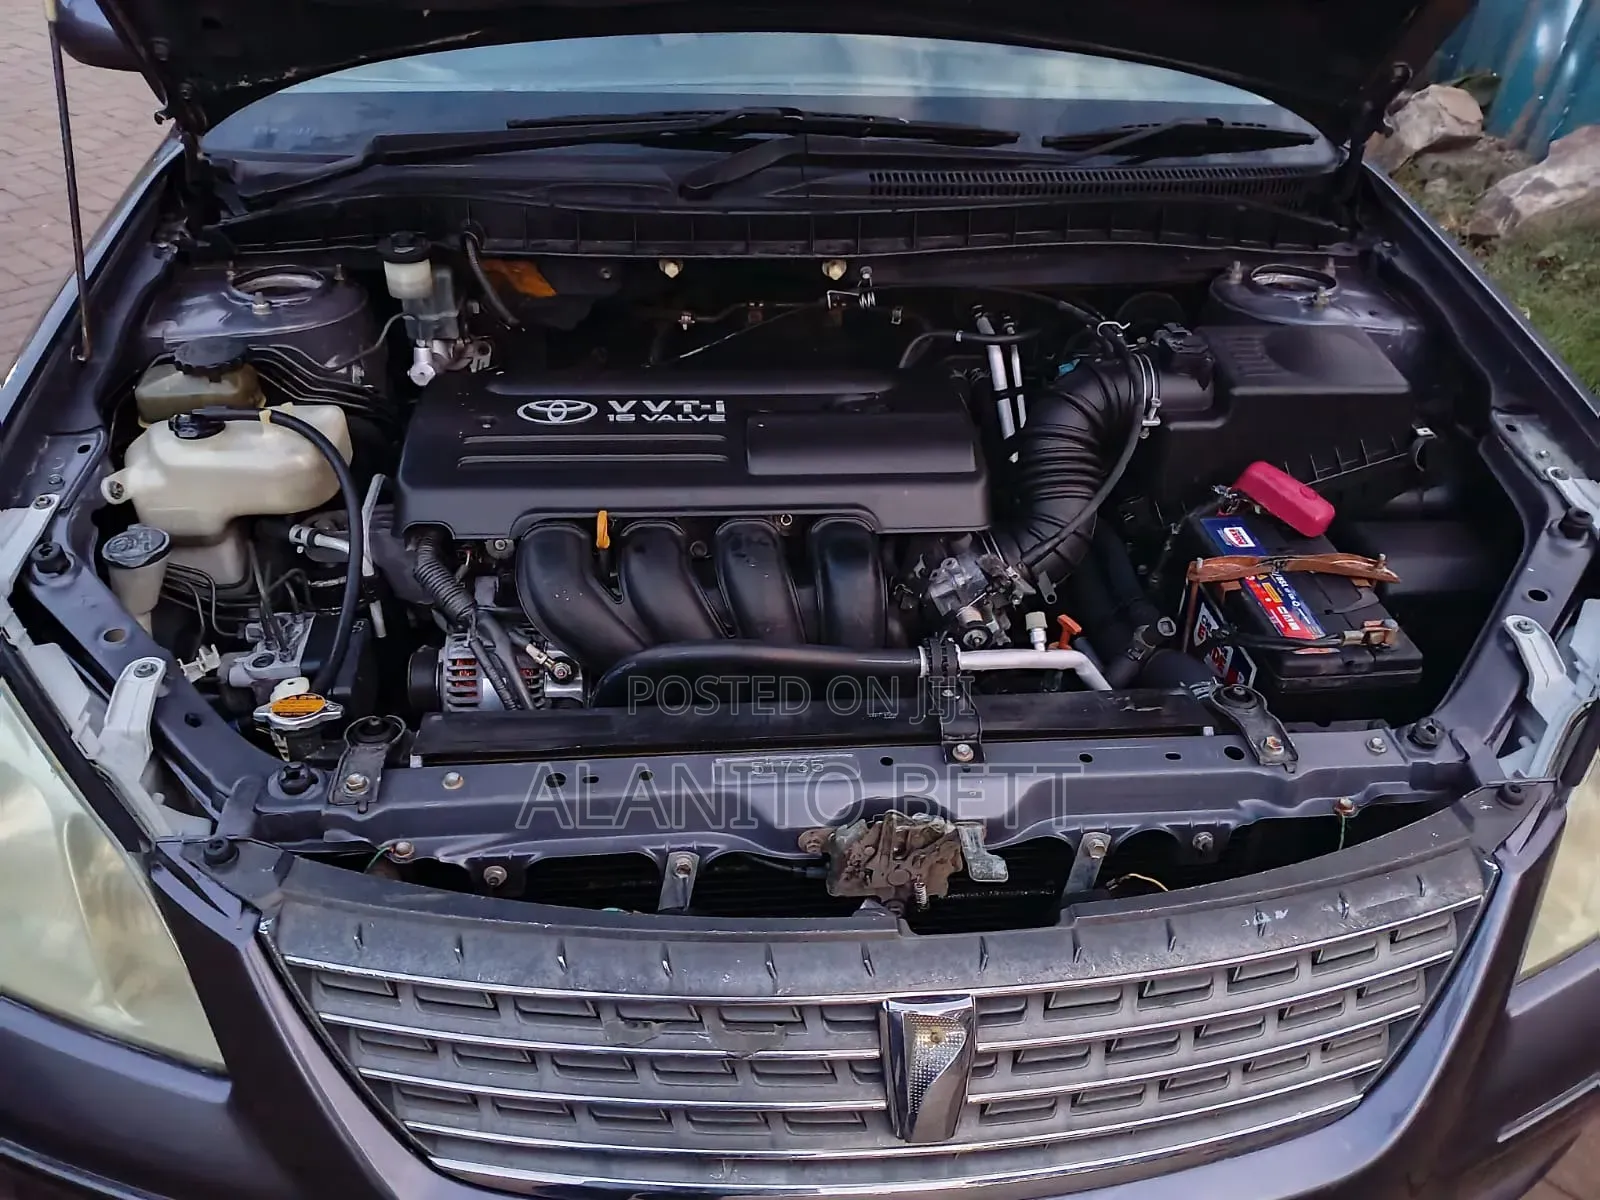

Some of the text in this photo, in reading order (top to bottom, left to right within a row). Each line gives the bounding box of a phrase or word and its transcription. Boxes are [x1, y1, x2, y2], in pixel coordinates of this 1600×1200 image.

[607, 413, 726, 422] 16 VALVE
[750, 757, 826, 775] 51735
